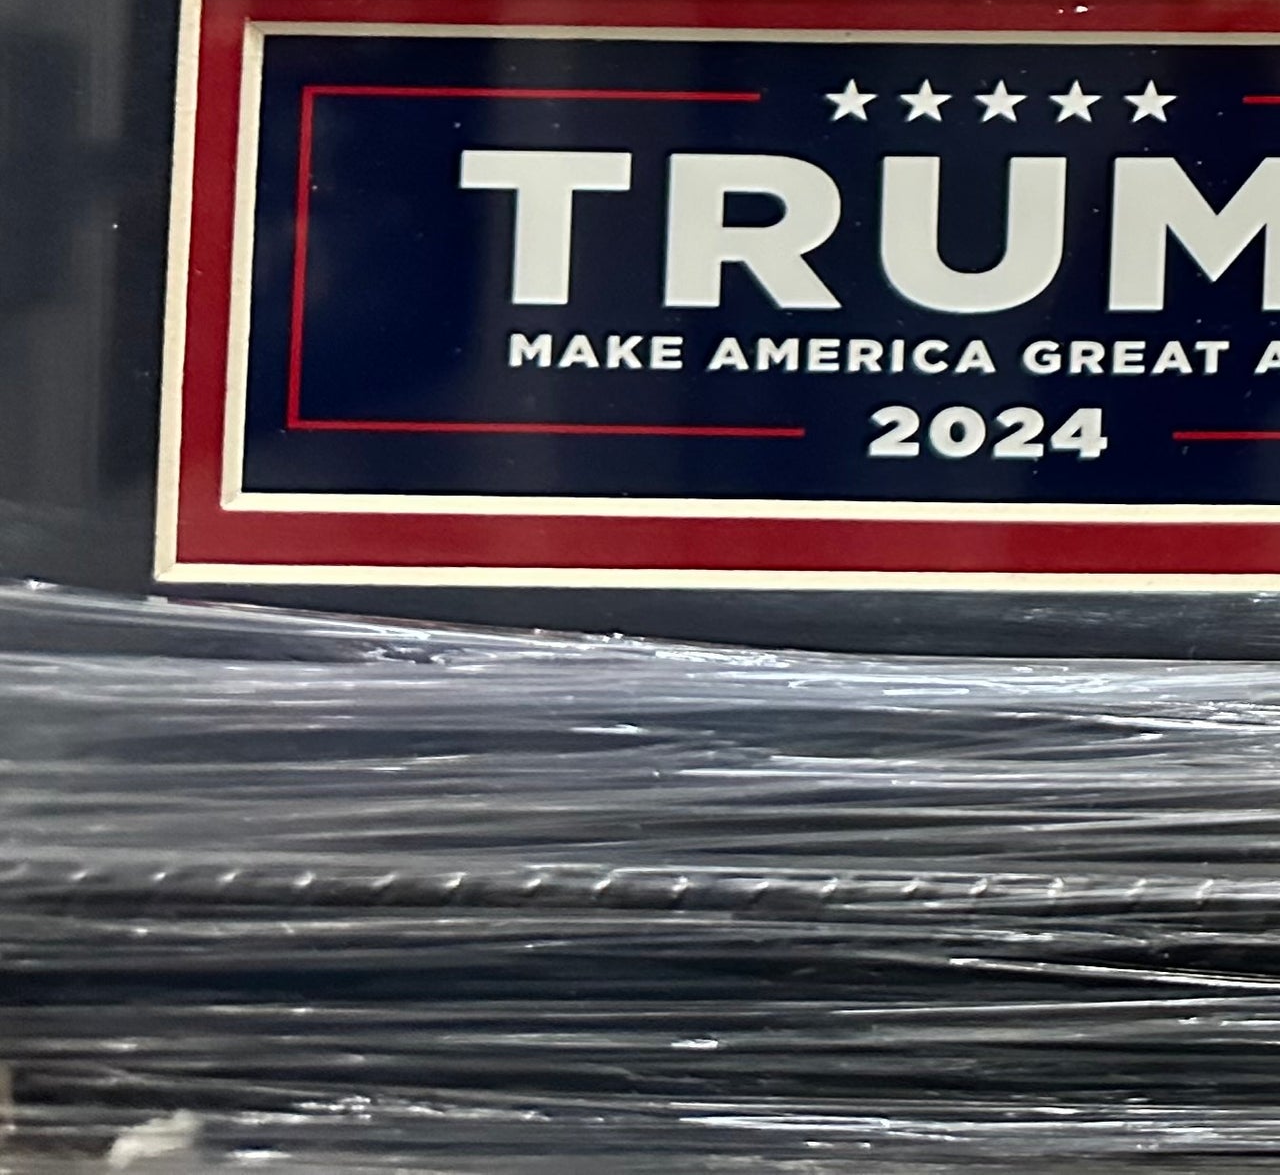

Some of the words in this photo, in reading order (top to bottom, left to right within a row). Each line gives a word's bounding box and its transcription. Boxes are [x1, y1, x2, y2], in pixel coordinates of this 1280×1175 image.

[507, 332, 684, 370] MAKE
[708, 336, 996, 374] AMERICA
[1022, 339, 1231, 376] GREAT
[868, 404, 1109, 460] 2024
